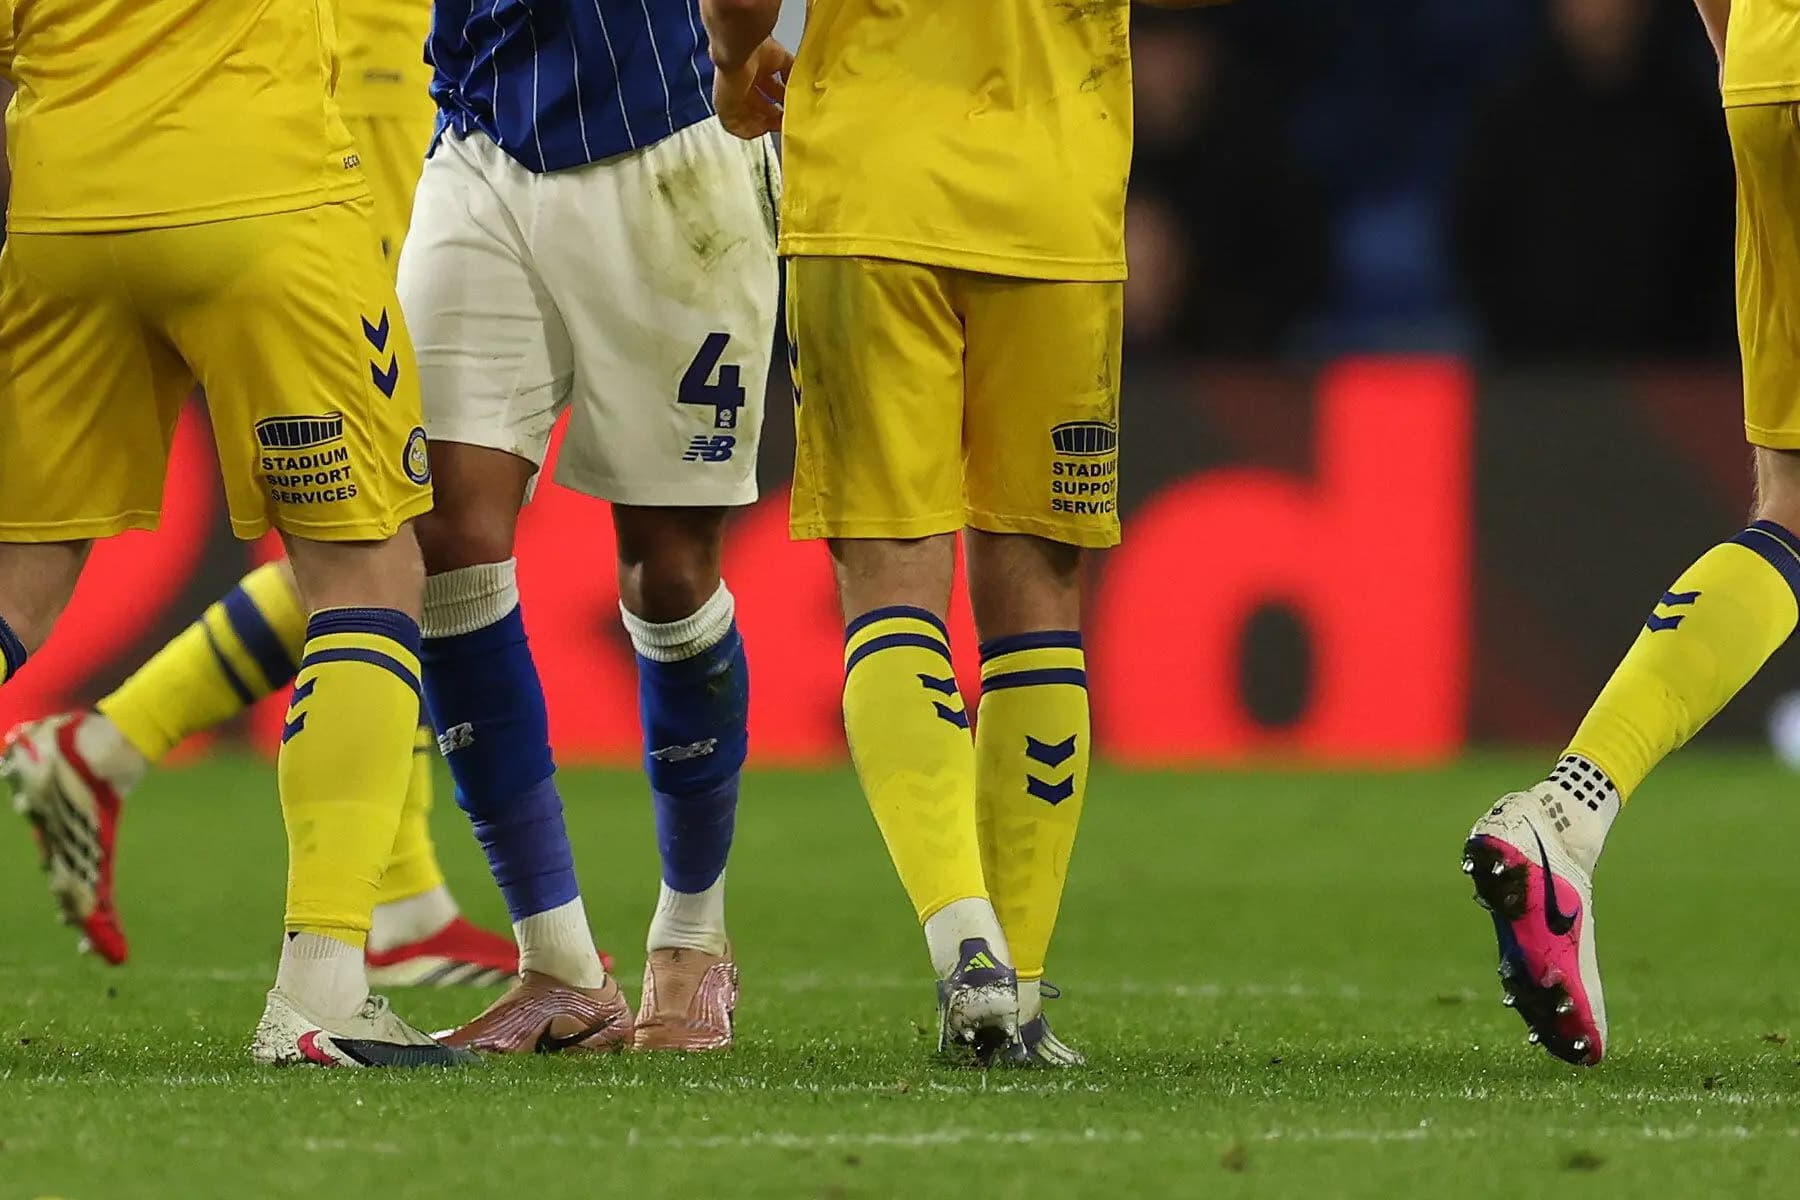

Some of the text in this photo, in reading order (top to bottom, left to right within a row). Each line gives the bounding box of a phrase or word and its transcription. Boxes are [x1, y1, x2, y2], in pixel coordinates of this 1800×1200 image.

[677, 332, 746, 428] 4
[262, 446, 349, 471] STADIUM
[266, 466, 352, 488] SUPPORT
[271, 484, 358, 504] SERVICES
